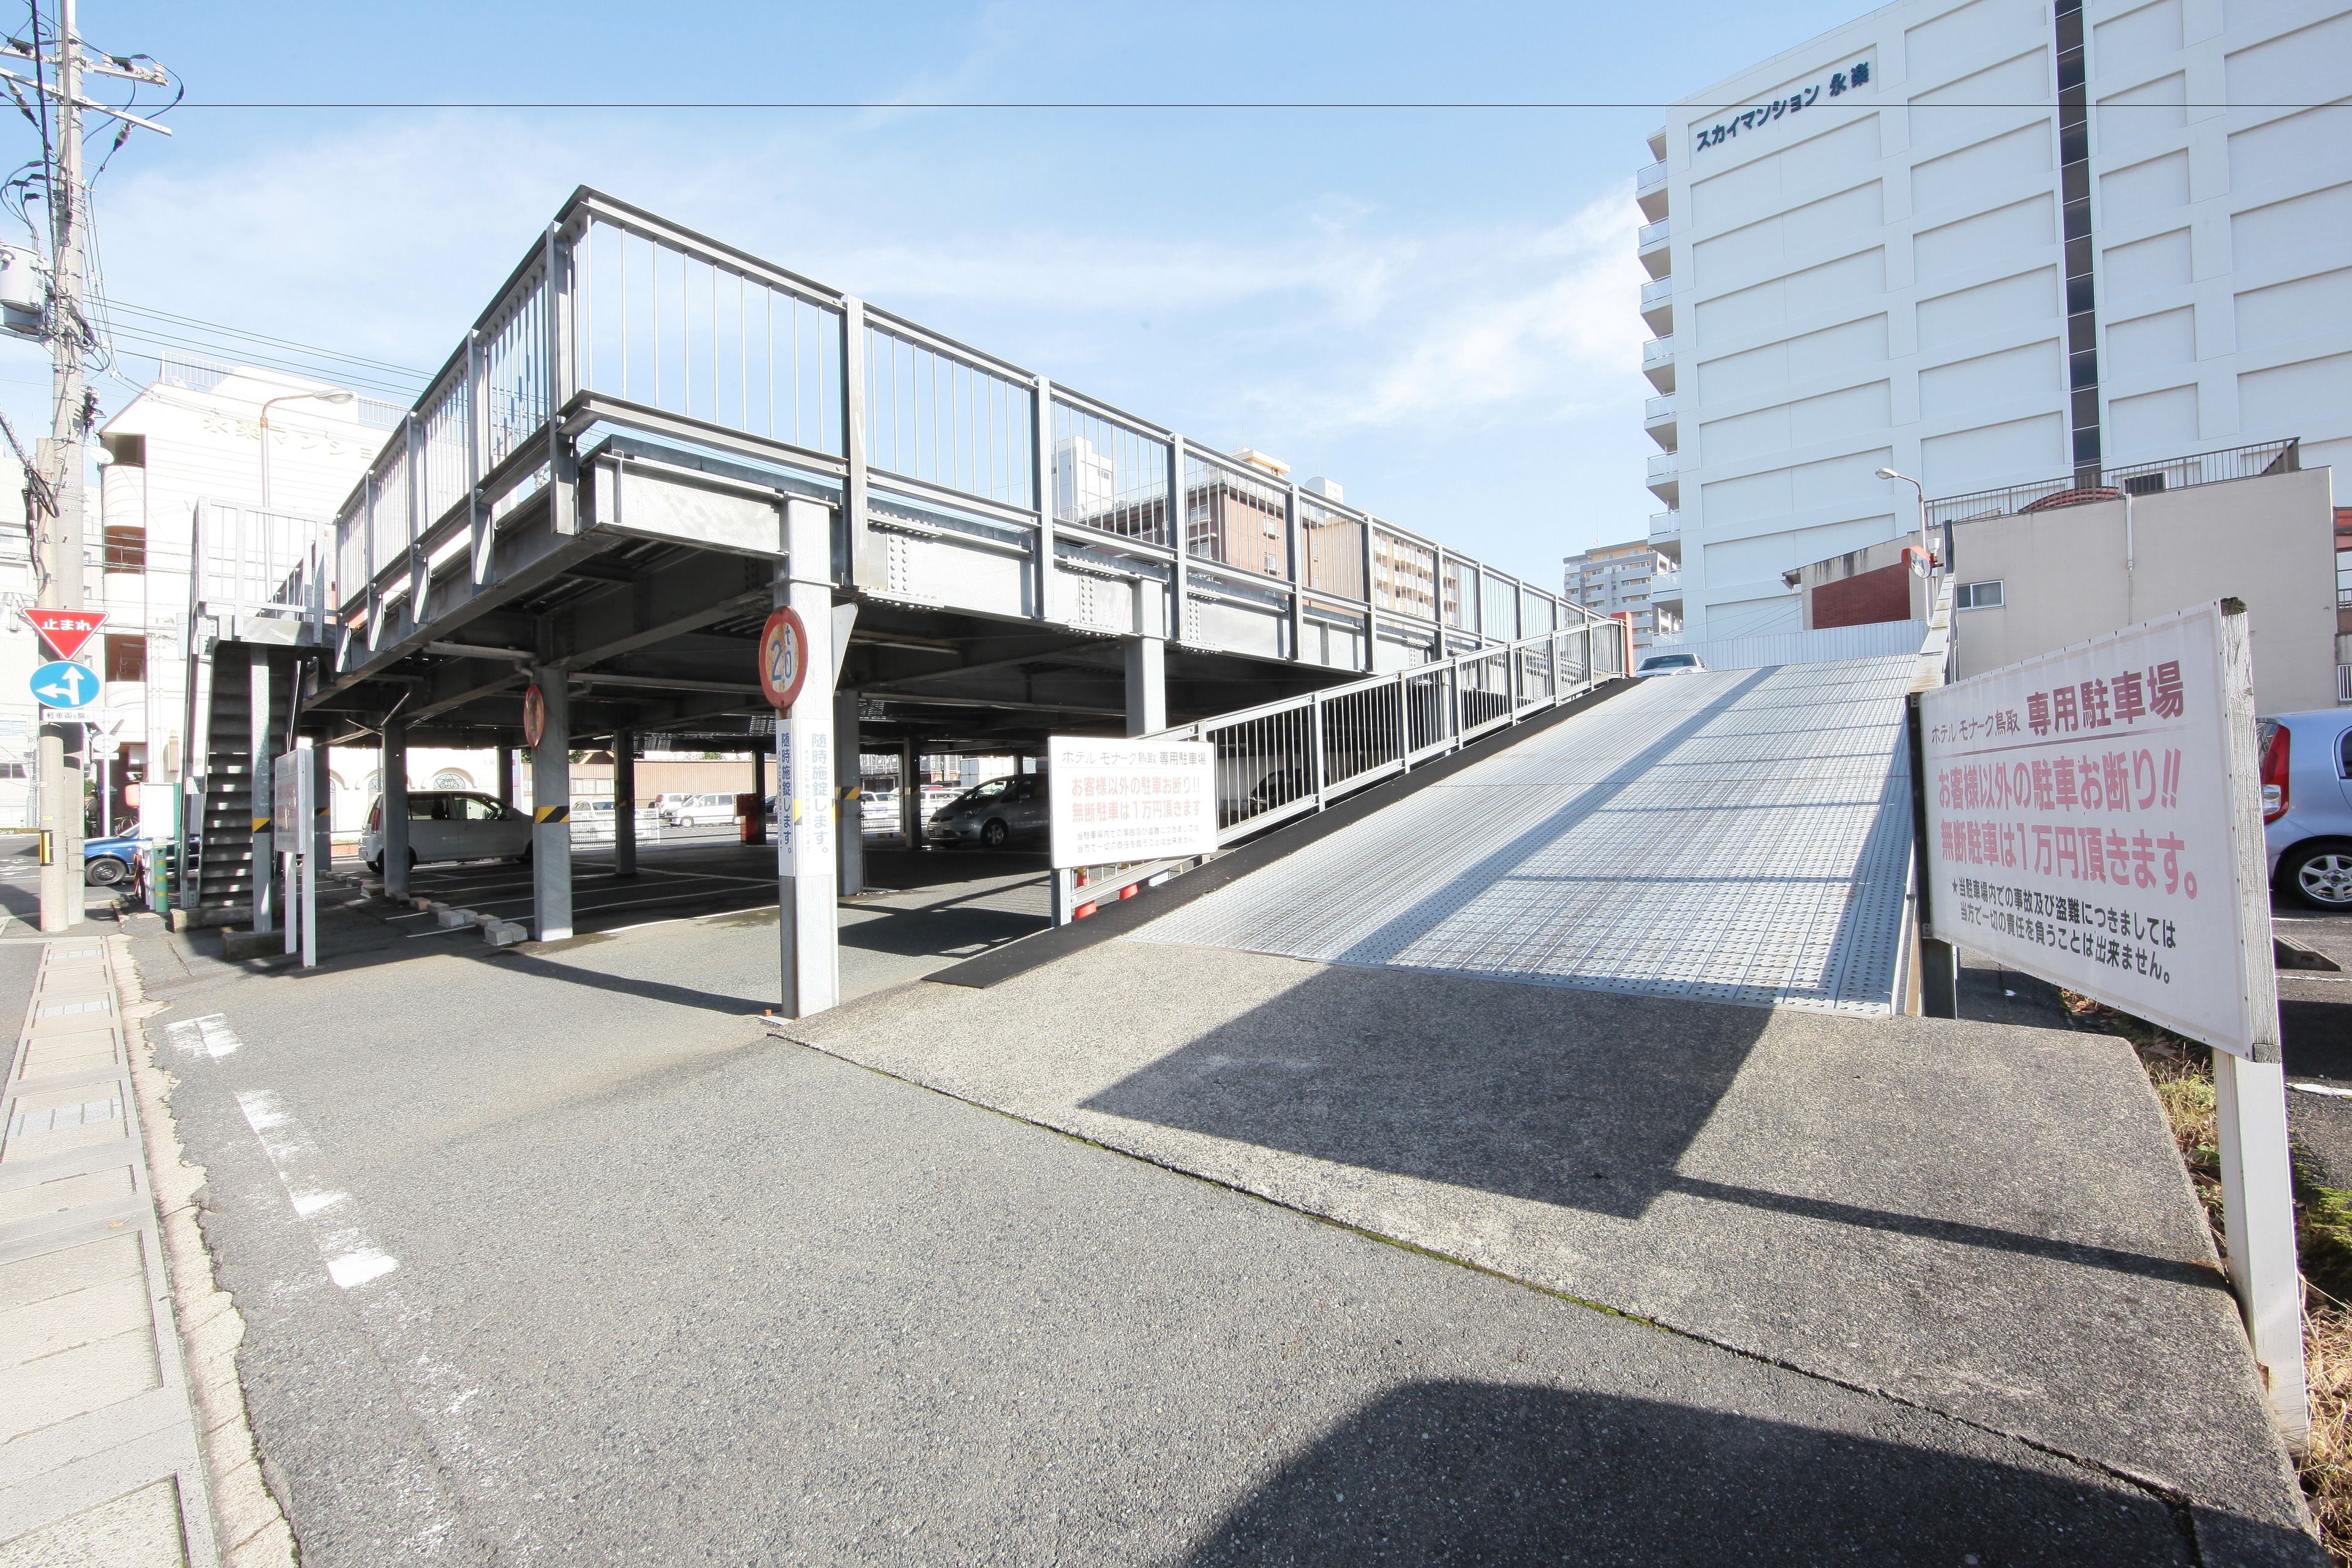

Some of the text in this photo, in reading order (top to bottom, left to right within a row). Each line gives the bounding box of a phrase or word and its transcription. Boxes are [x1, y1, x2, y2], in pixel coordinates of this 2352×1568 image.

[1697, 61, 1869, 152] スカイマンション 永楽
[42, 618, 92, 631] 止まれ
[1931, 660, 2184, 745] ホテル モナーク鳥取 専用駐車場
[781, 732, 792, 854] 随時施錠します。
[812, 733, 828, 853] 随時施錠します。
[1062, 751, 1207, 766] ホテル モナーク鳥取 専用駐車場
[1960, 901, 2170, 984] 当方で一切の責任を負うことは出来ません。
